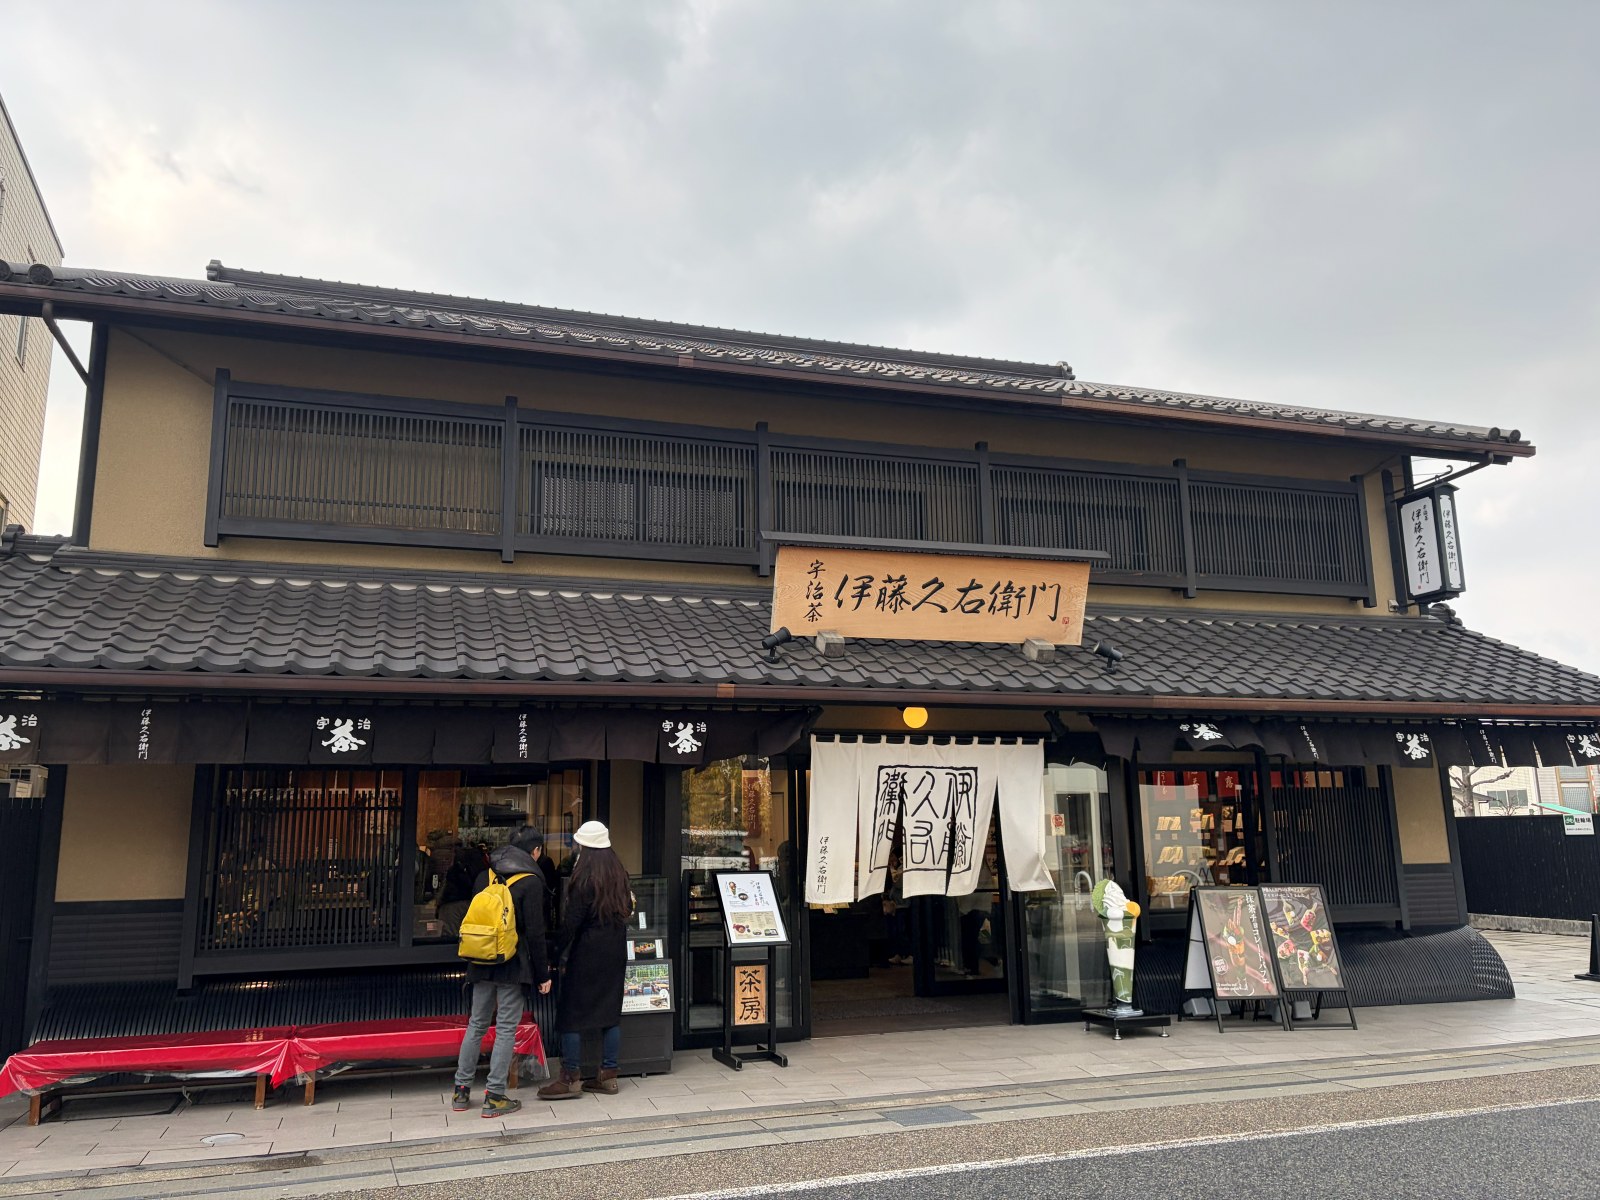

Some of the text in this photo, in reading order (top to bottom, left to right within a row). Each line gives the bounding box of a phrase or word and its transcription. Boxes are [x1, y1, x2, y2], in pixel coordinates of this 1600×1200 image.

[1411, 508, 1430, 584] 伊藤久右衛門
[1442, 509, 1458, 571] 伊藤久右衛門
[802, 559, 826, 623] 宇治茶
[833, 573, 1062, 622] 伊藤久右衛門
[138, 709, 152, 760] 伊藤久右衛門
[518, 714, 528, 759] 伊藤久右衛門
[816, 836, 829, 893] 伊藤久右衛門
[1245, 893, 1270, 984] 抹茶チョコレートパフェ
[739, 969, 761, 1020] 茶房
